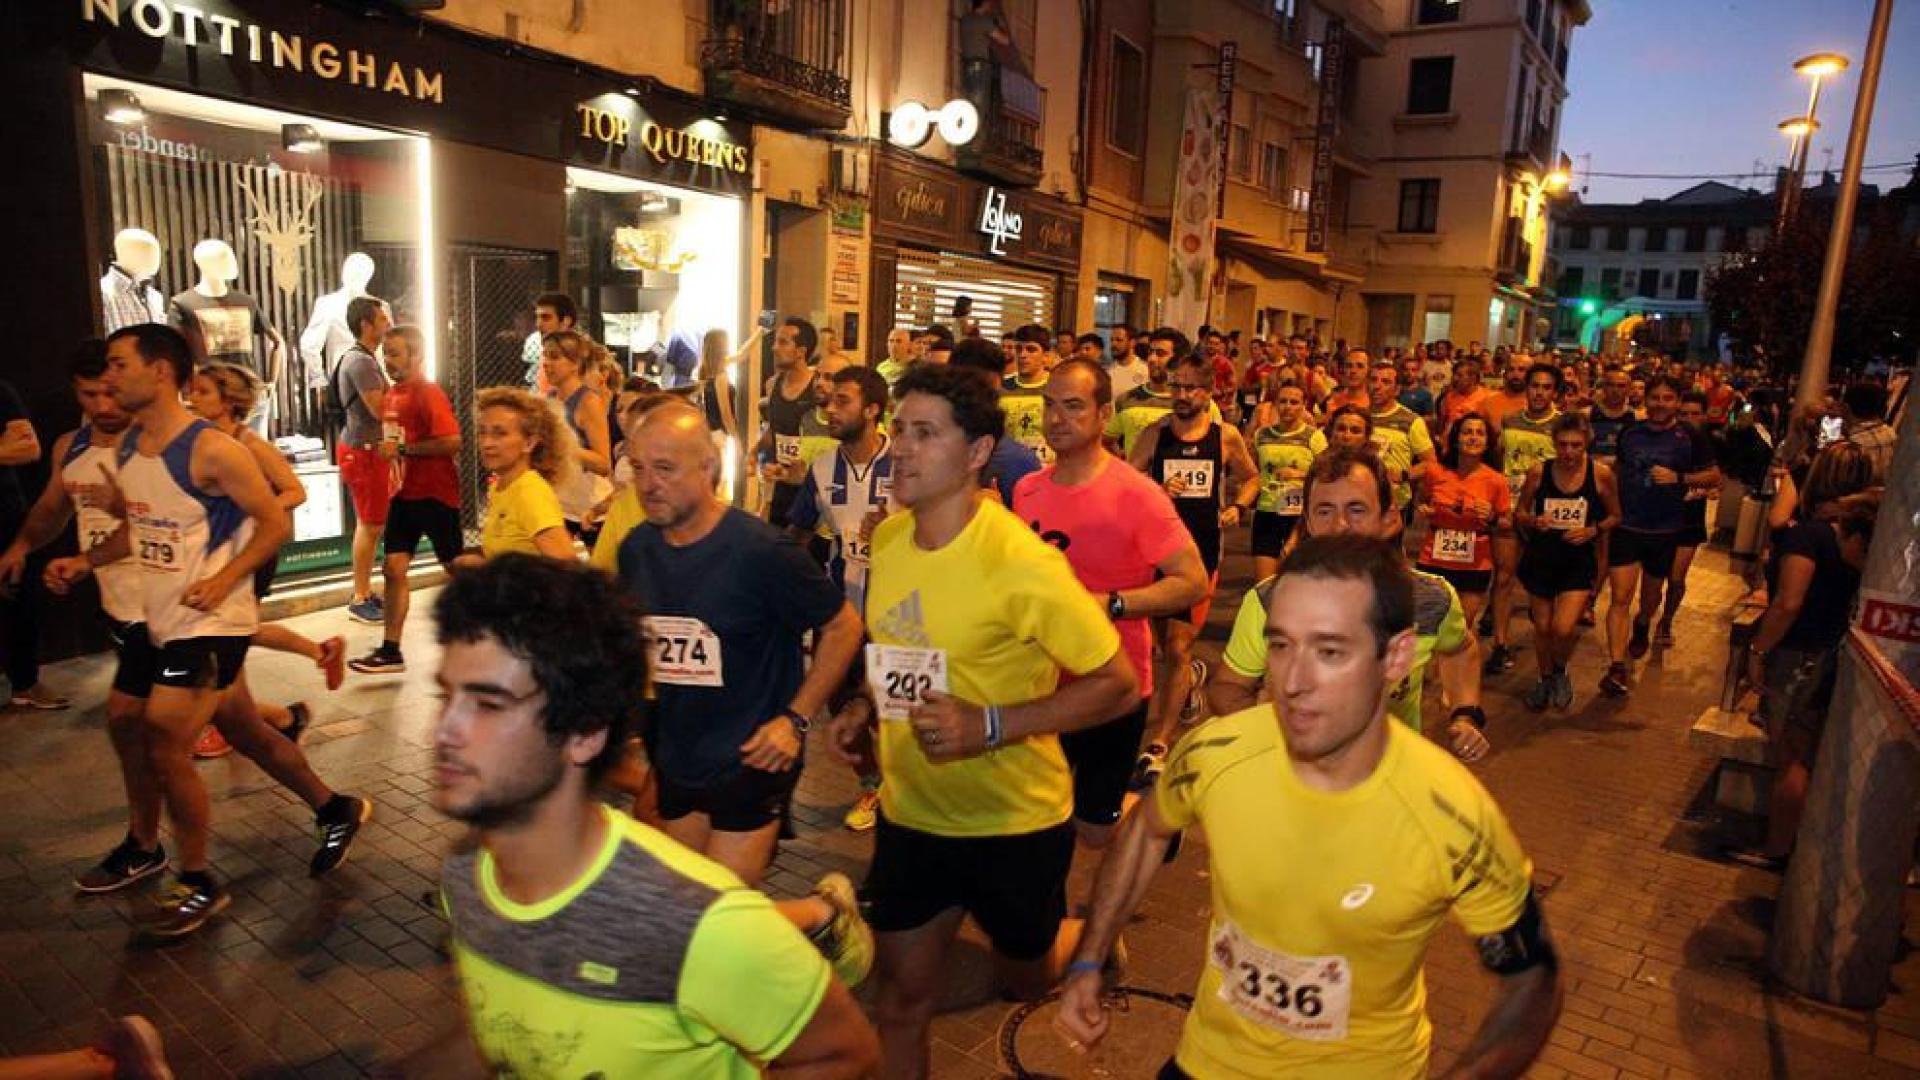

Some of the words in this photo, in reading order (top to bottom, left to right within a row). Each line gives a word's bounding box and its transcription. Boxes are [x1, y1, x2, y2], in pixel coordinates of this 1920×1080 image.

[82, 0, 443, 103] NOTTINGHAM
[577, 103, 631, 146] TOP
[641, 117, 748, 174] QUEENS
[1553, 507, 1581, 520] 124
[138, 540, 174, 563] 279
[1442, 538, 1467, 552] 234
[656, 637, 708, 666] 274
[1239, 961, 1324, 1018] 336
